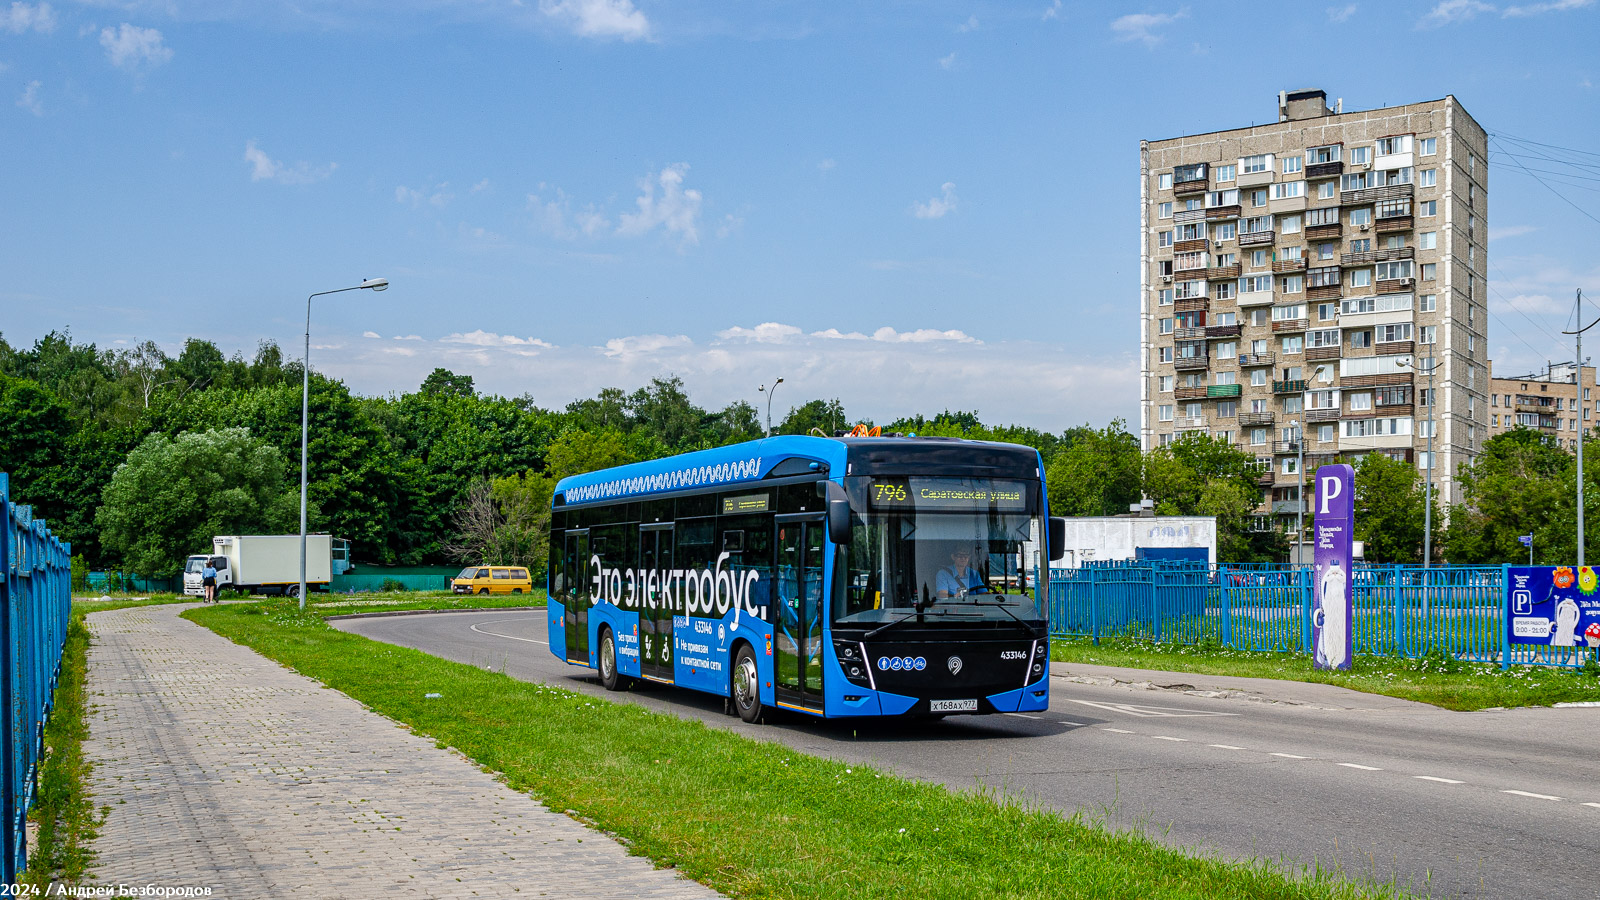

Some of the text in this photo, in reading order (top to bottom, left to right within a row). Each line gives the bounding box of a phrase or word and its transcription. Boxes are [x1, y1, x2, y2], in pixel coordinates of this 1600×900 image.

[874, 484, 907, 501] 796
[920, 488, 1020, 502] Саратовская улица
[1320, 476, 1342, 514] P
[590, 551, 767, 632] Это электробус.
[1516, 593, 1528, 611] P
[694, 620, 713, 635] 433146
[1531, 626, 1548, 634] 21:00
[680, 638, 688, 651] Не
[687, 642, 709, 654] привязан
[1000, 650, 1027, 660] 433146
[684, 657, 709, 669] контактной
[709, 661, 722, 672] сети
